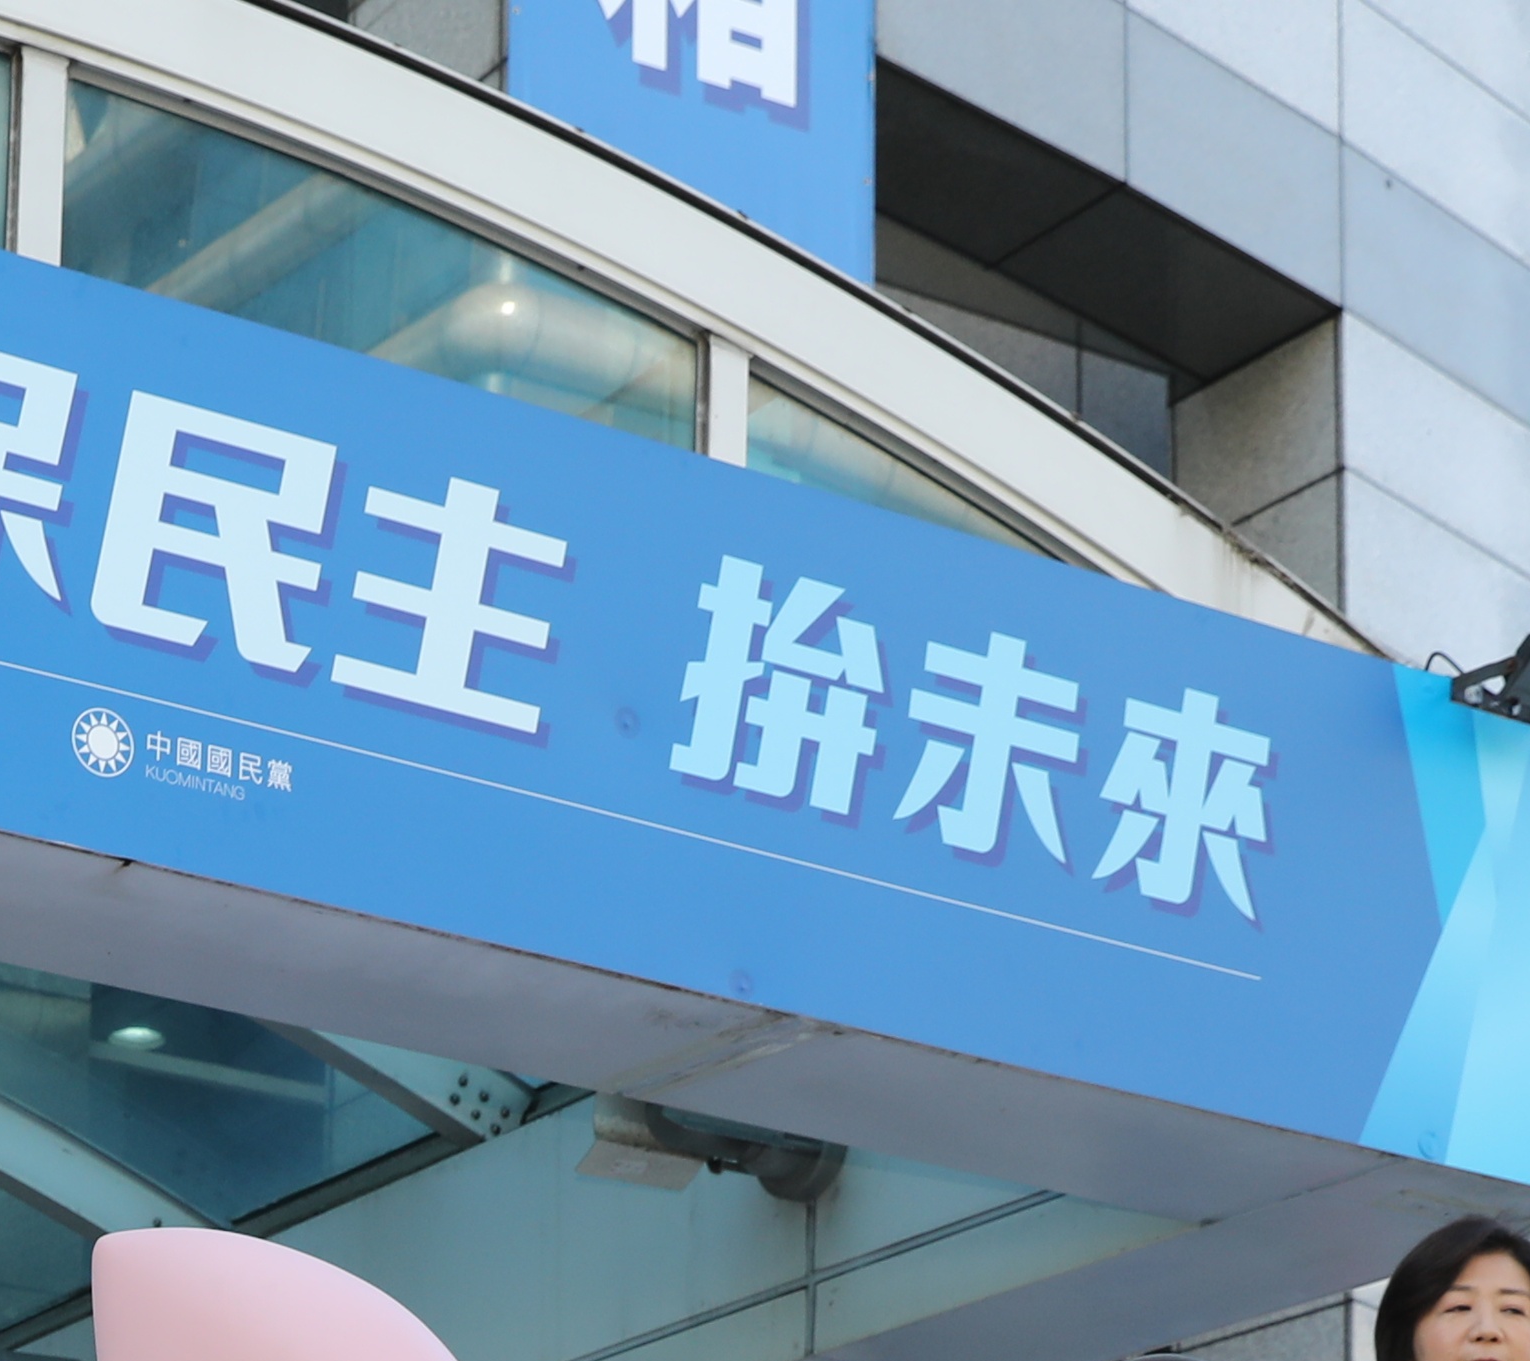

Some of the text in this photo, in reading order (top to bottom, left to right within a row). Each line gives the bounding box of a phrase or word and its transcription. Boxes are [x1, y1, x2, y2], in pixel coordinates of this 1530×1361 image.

[145, 729, 294, 793] 中國國民黨
[668, 552, 1276, 923] 拚未來
[144, 763, 247, 802] KUOMINTANG
